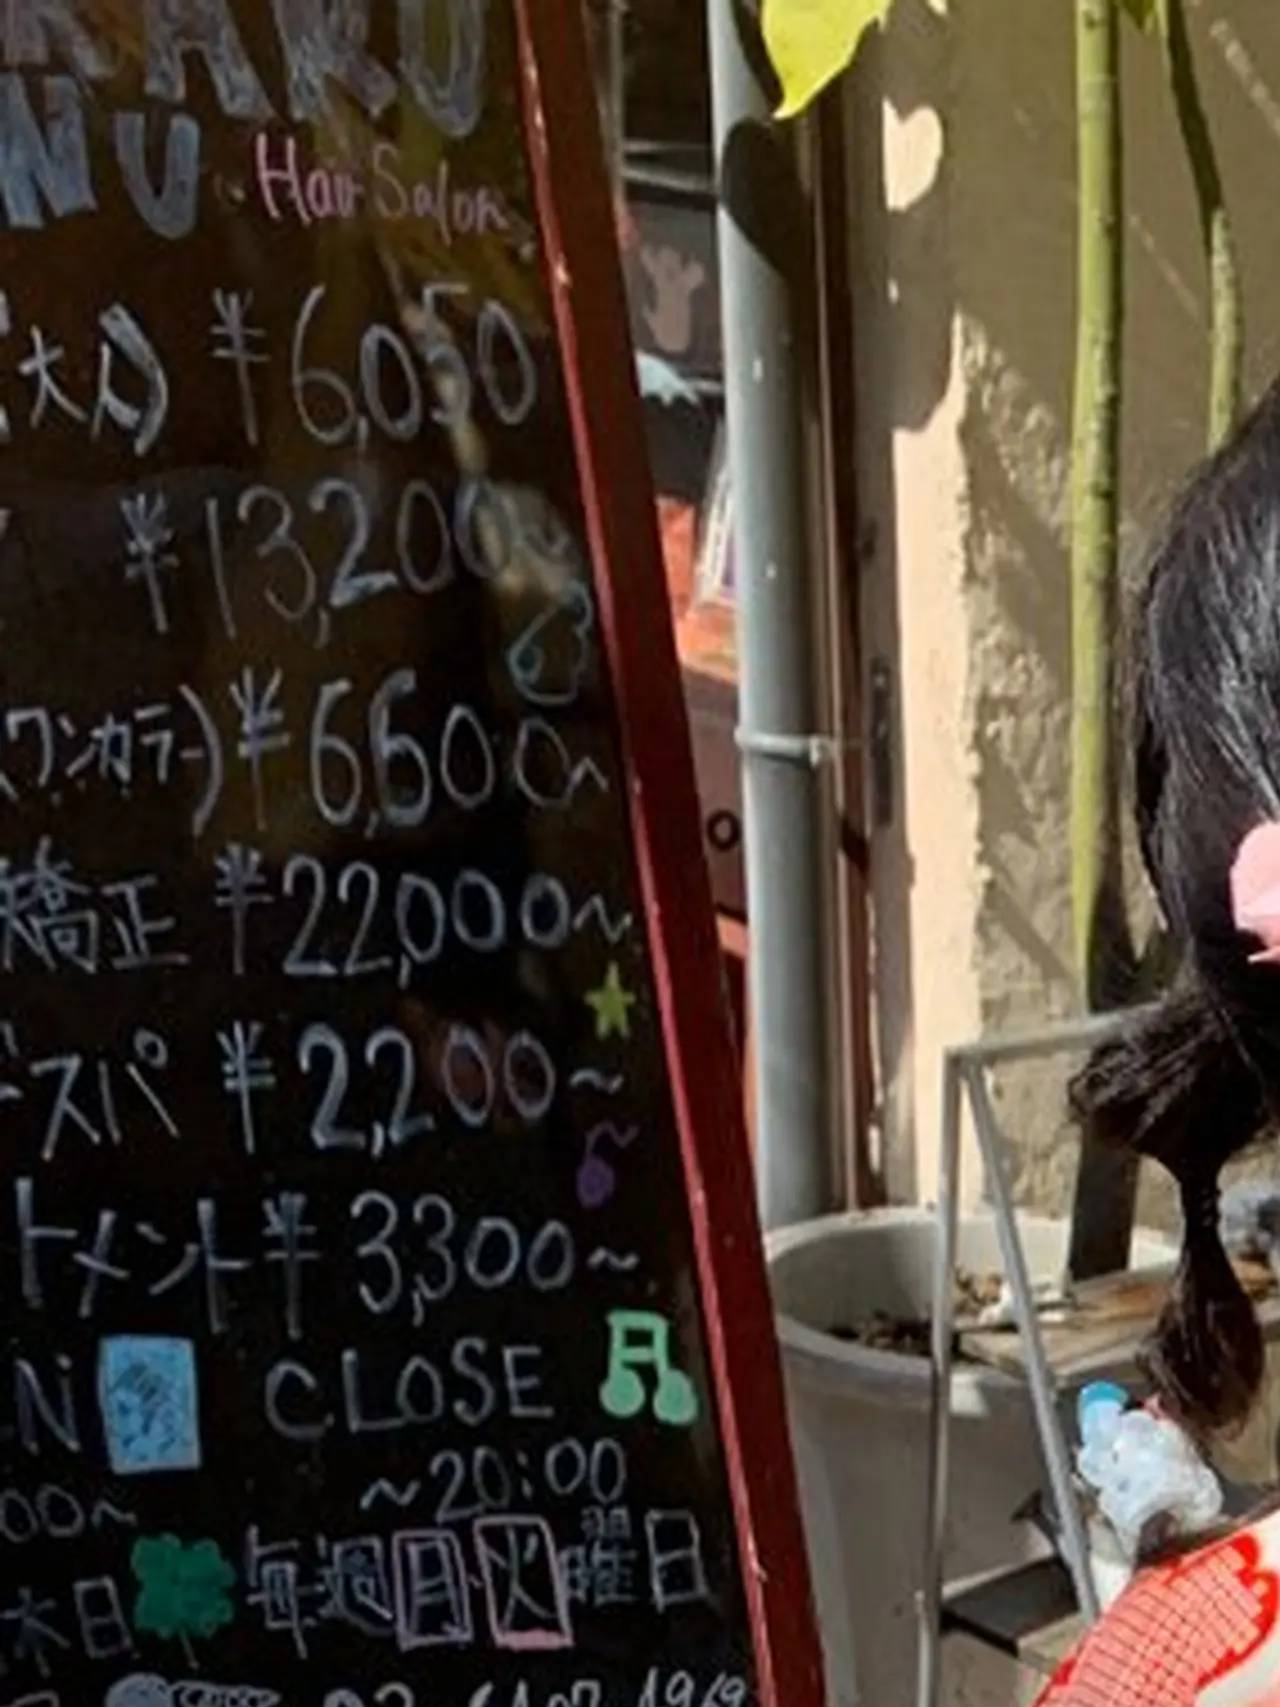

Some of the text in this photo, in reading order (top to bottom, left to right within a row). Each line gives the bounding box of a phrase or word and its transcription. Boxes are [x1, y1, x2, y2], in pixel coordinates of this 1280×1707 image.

[372, 142, 510, 247] Salon
[211, 283, 537, 462] ¥6,050
[0, 683, 224, 838] ワンカラー)
[264, 1336, 555, 1441] CLOSE
